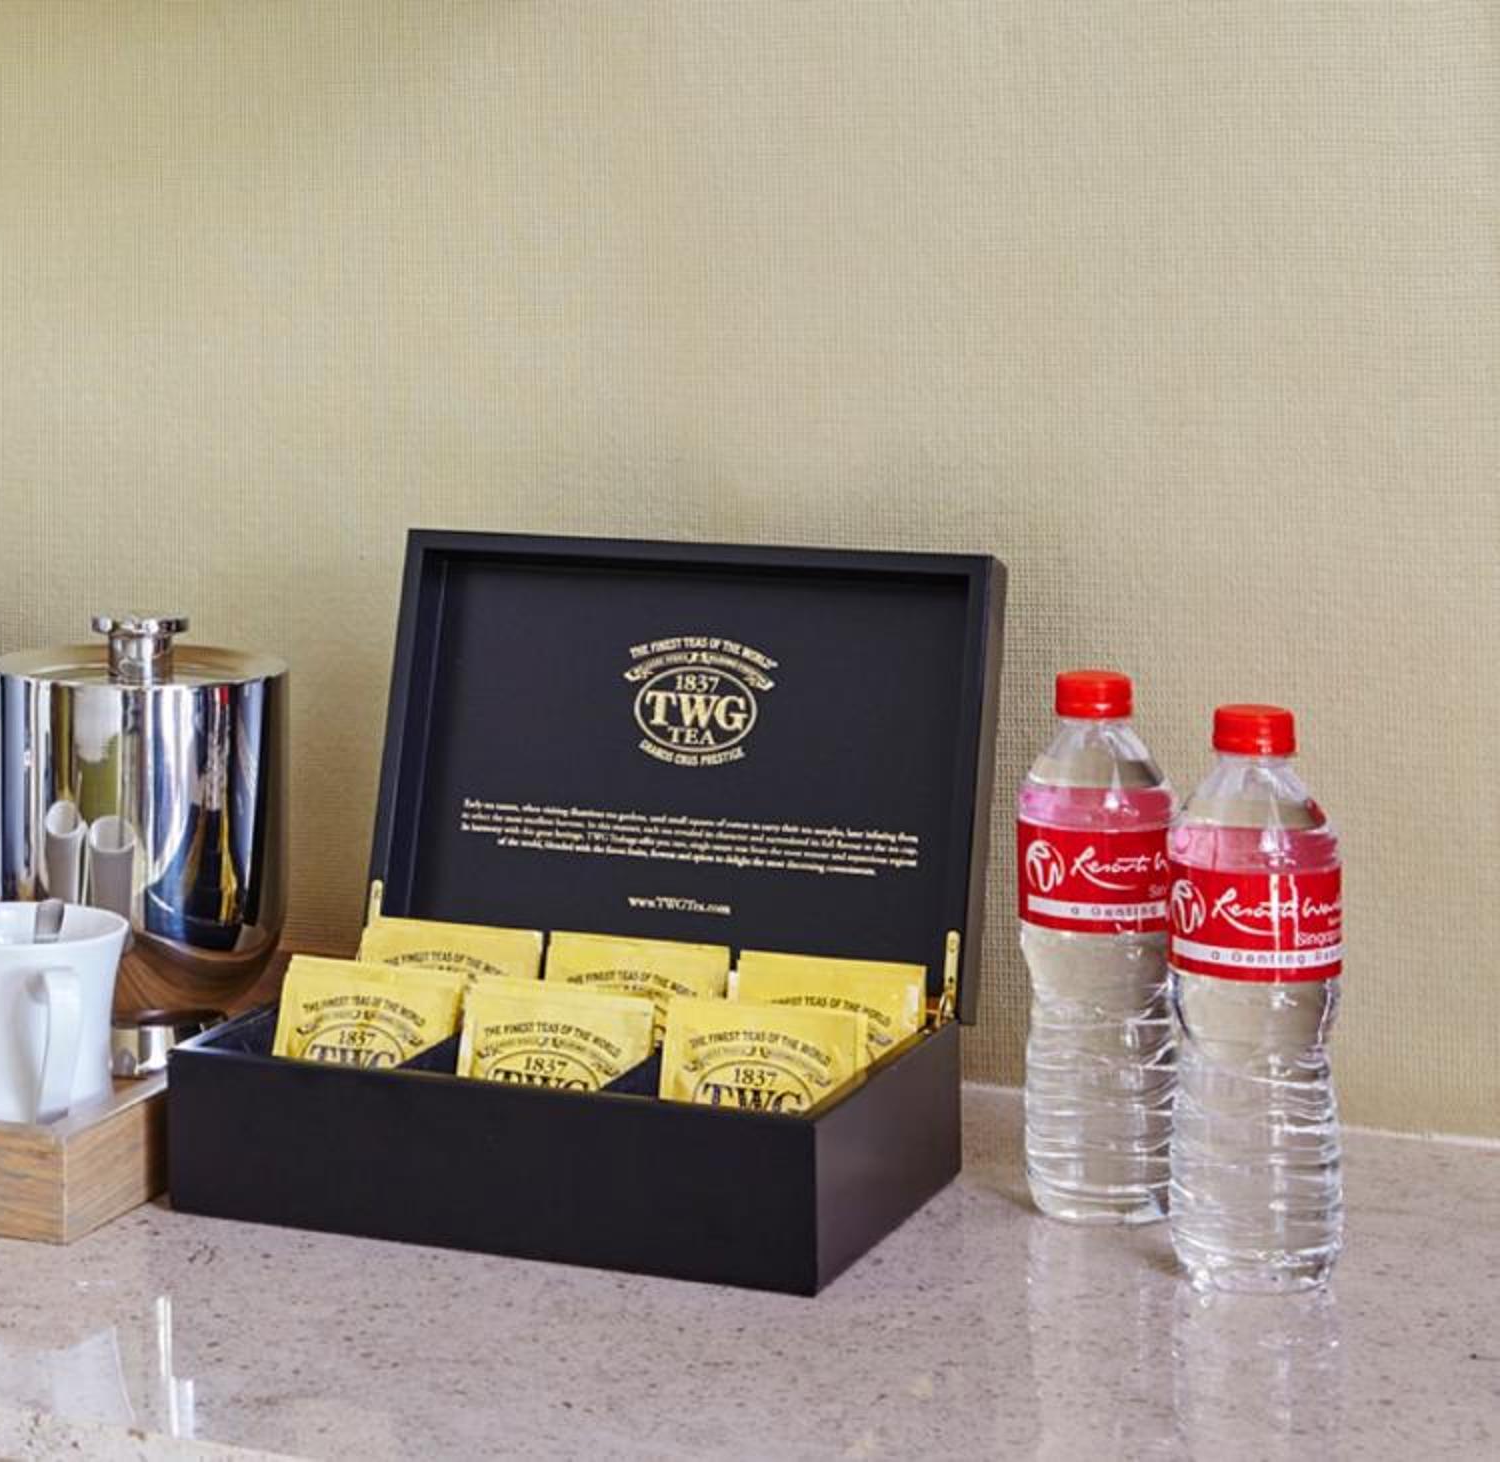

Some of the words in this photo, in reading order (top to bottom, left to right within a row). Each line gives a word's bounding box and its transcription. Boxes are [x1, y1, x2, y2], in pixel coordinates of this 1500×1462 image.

[675, 673, 720, 693] 1837
[645, 689, 749, 732] TWG
[667, 726, 716, 745] TEA
[1231, 951, 1307, 966] Genting
[804, 996, 828, 1008] TEAS
[829, 997, 843, 1009] OF
[338, 1029, 377, 1047] 1837
[484, 1025, 501, 1038] THE
[503, 1022, 535, 1035] FINEST
[536, 1020, 559, 1033] TEAS
[559, 1022, 573, 1035] OF
[573, 1026, 593, 1042] THE
[689, 1036, 706, 1049] THE
[708, 1030, 741, 1045] FINEST
[742, 1030, 766, 1042] TEAS
[766, 1031, 781, 1044] OF
[781, 1034, 800, 1049] THE
[800, 1042, 833, 1066] WORLD
[523, 1055, 569, 1074] 1837
[733, 1067, 778, 1088] 1837
